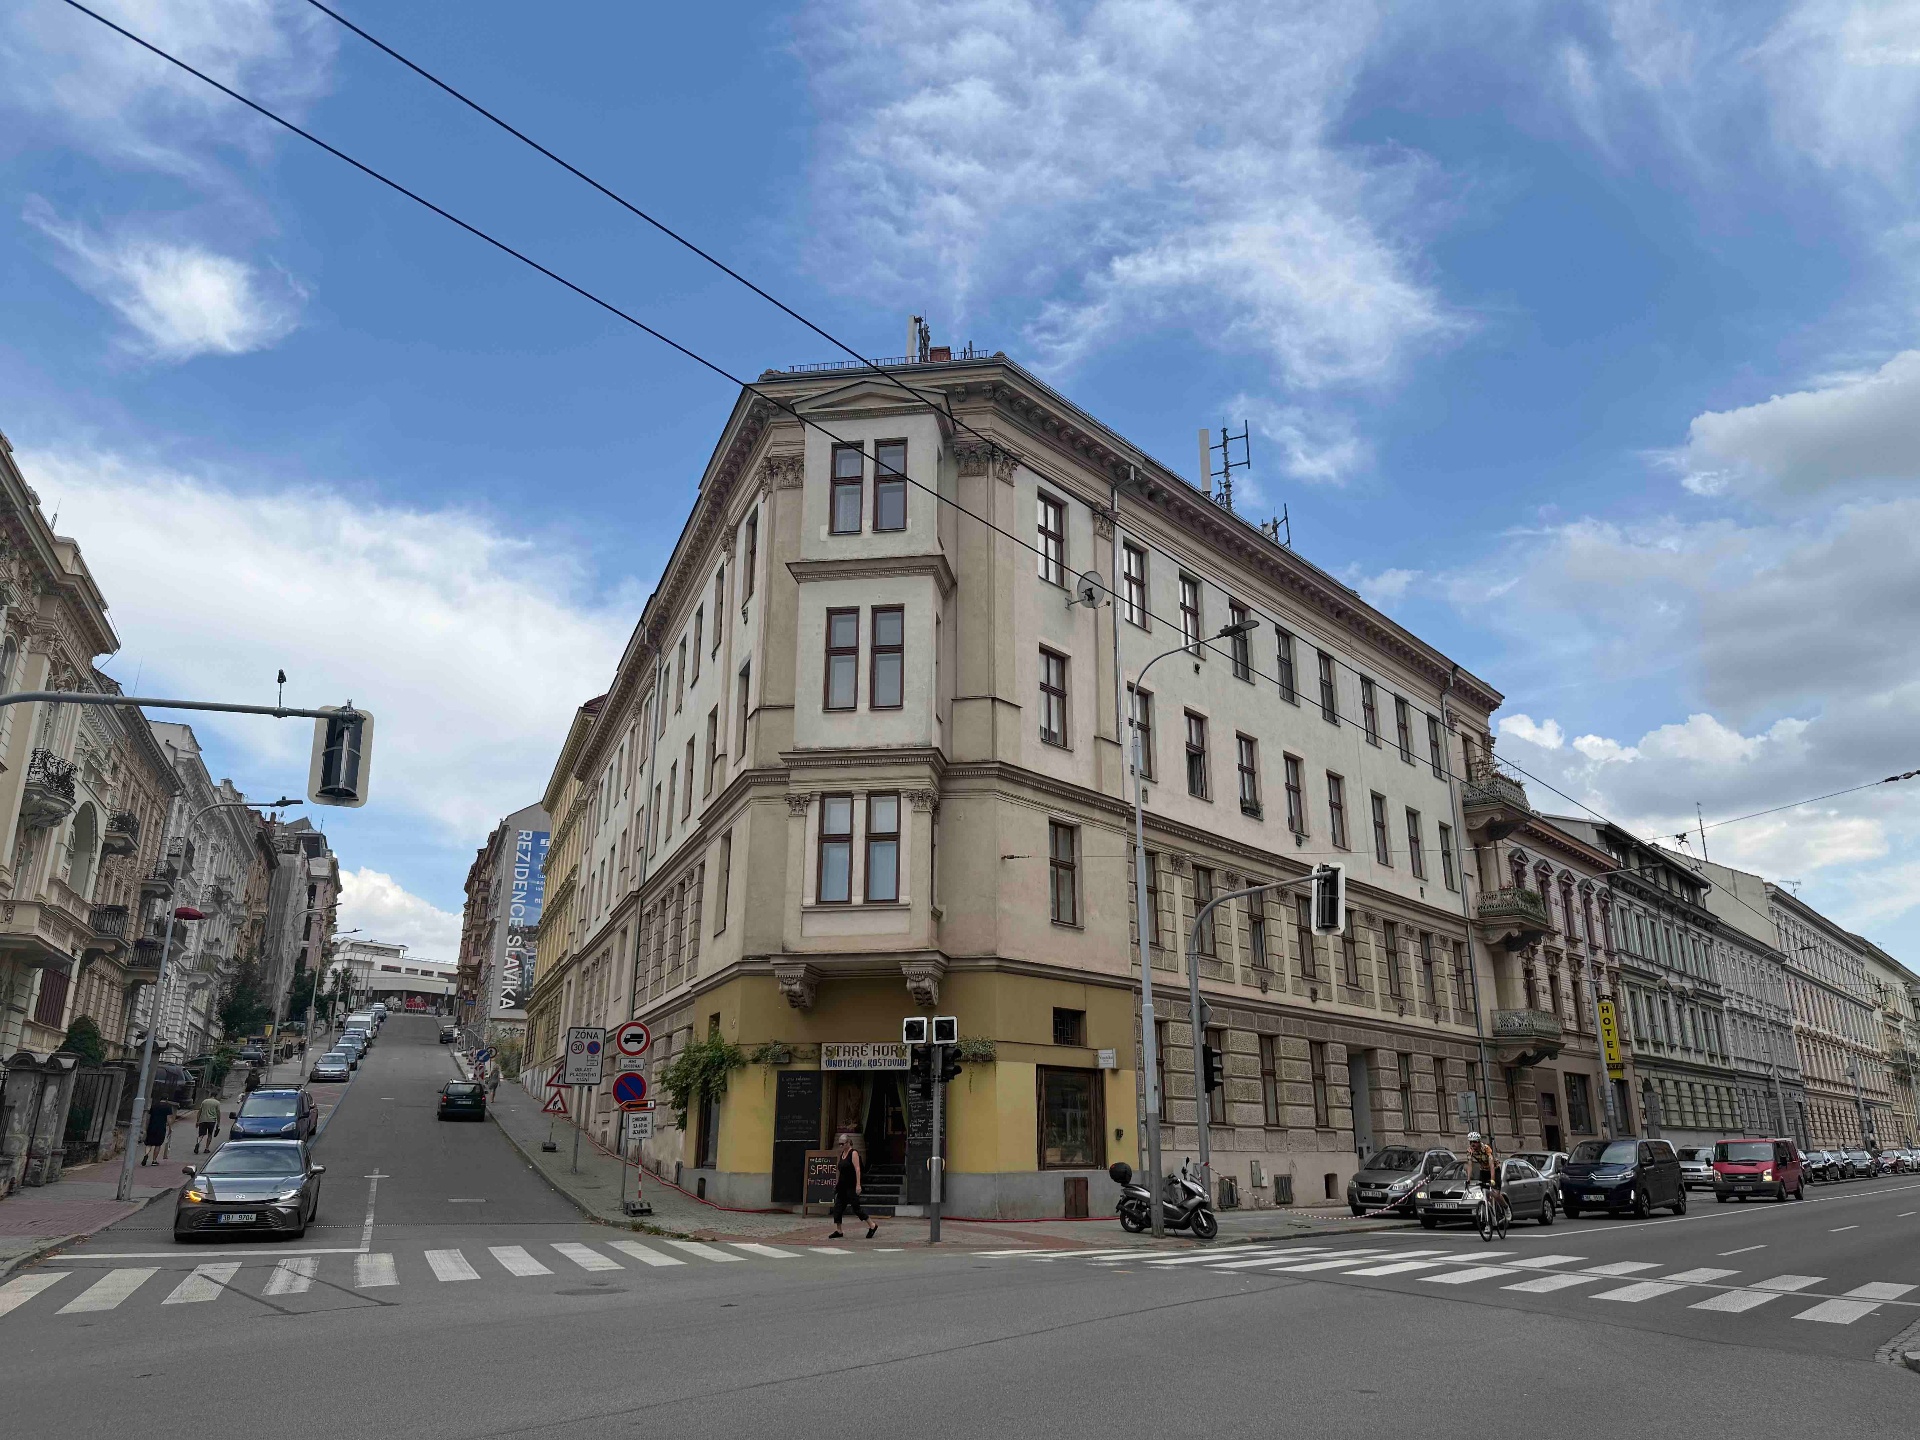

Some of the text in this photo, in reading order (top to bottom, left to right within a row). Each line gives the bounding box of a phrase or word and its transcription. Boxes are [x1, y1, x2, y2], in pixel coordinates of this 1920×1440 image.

[508, 830, 532, 927] REZIDENCE
[500, 935, 522, 1009] SLAVÍKA
[573, 1043, 583, 1052] 30
[574, 1029, 599, 1040] ZÓNA
[1601, 1006, 1616, 1060] HOTEL
[825, 1043, 908, 1058] STARÉ HORY
